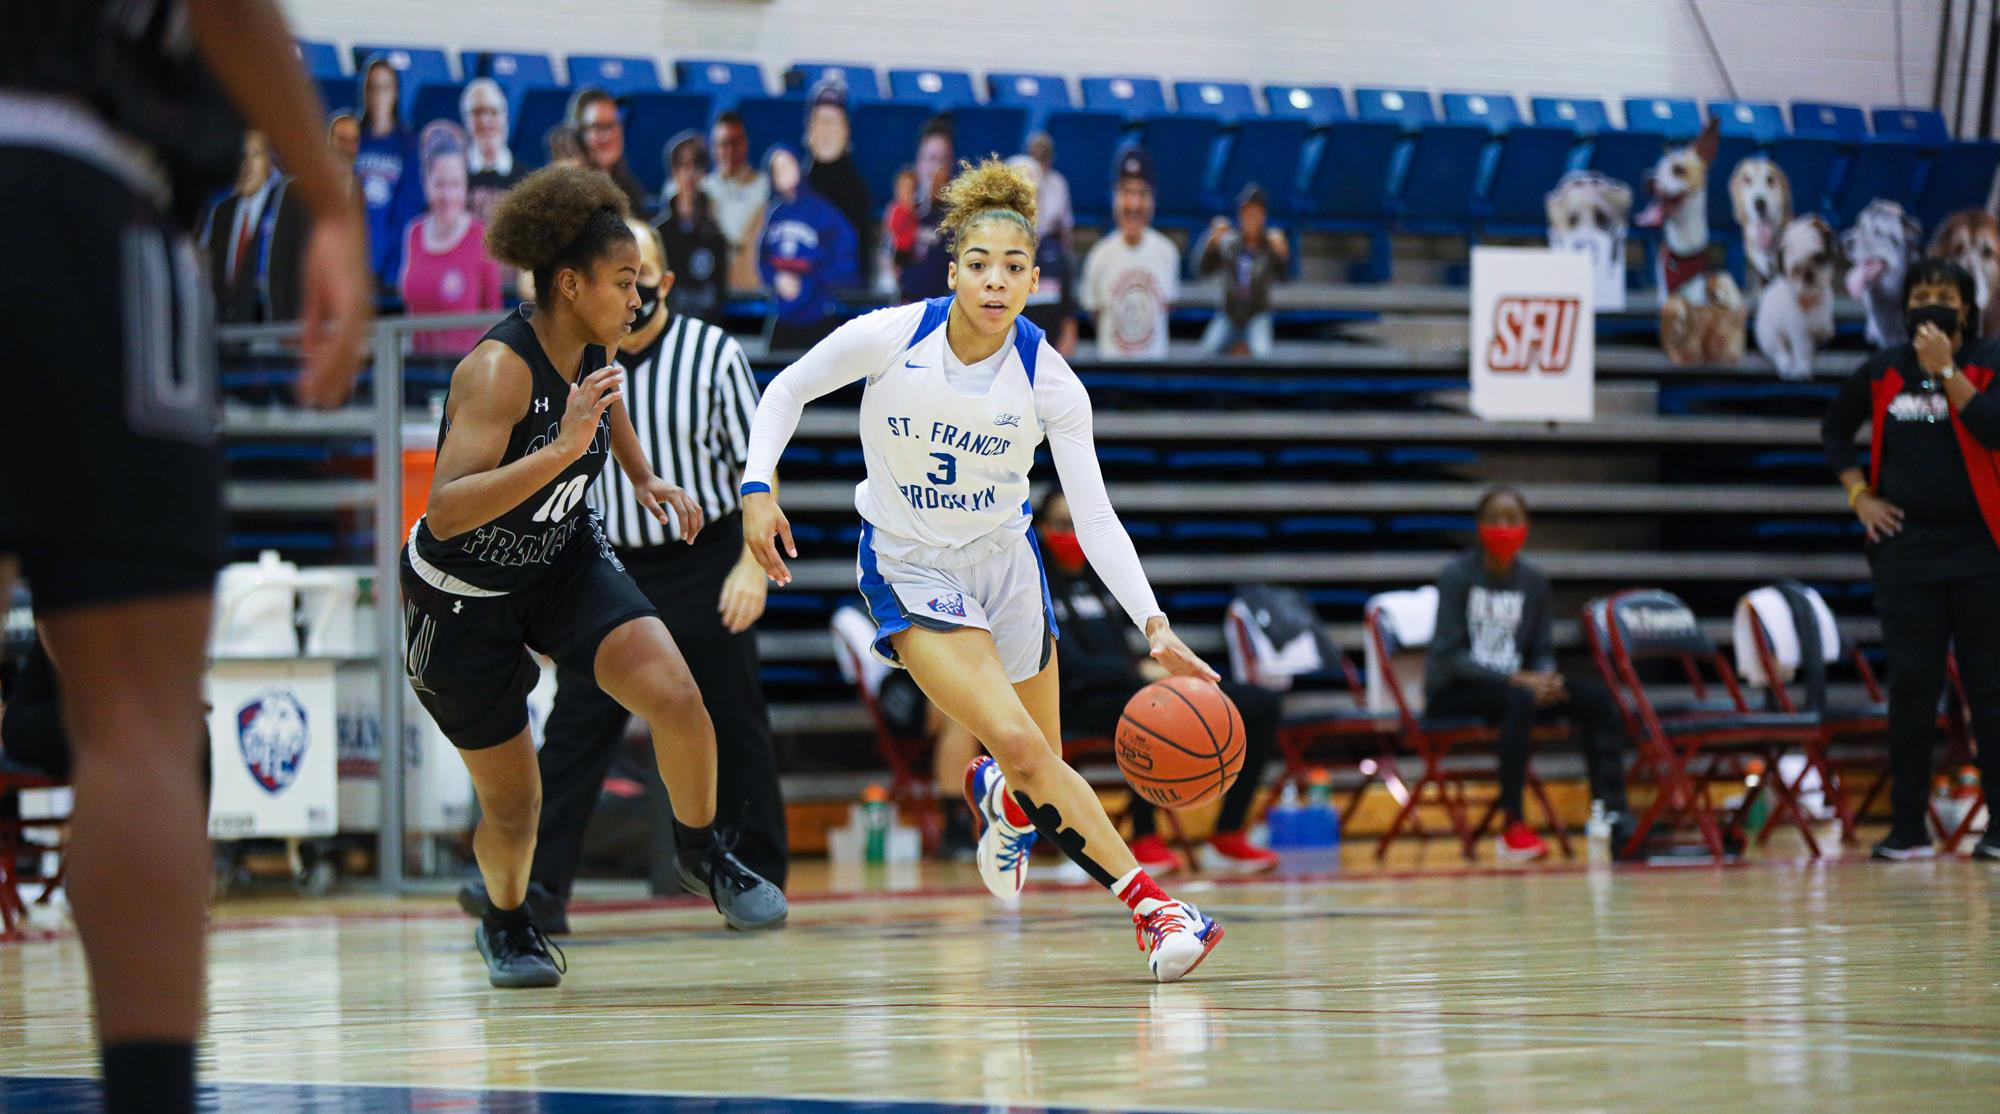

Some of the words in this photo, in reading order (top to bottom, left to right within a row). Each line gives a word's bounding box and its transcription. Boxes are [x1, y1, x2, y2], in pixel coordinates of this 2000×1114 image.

[1488, 295, 1581, 375] SFU
[887, 416, 920, 440] ST.
[930, 421, 1012, 457] FRANCIS
[926, 452, 957, 486] 3
[531, 474, 589, 524] 10
